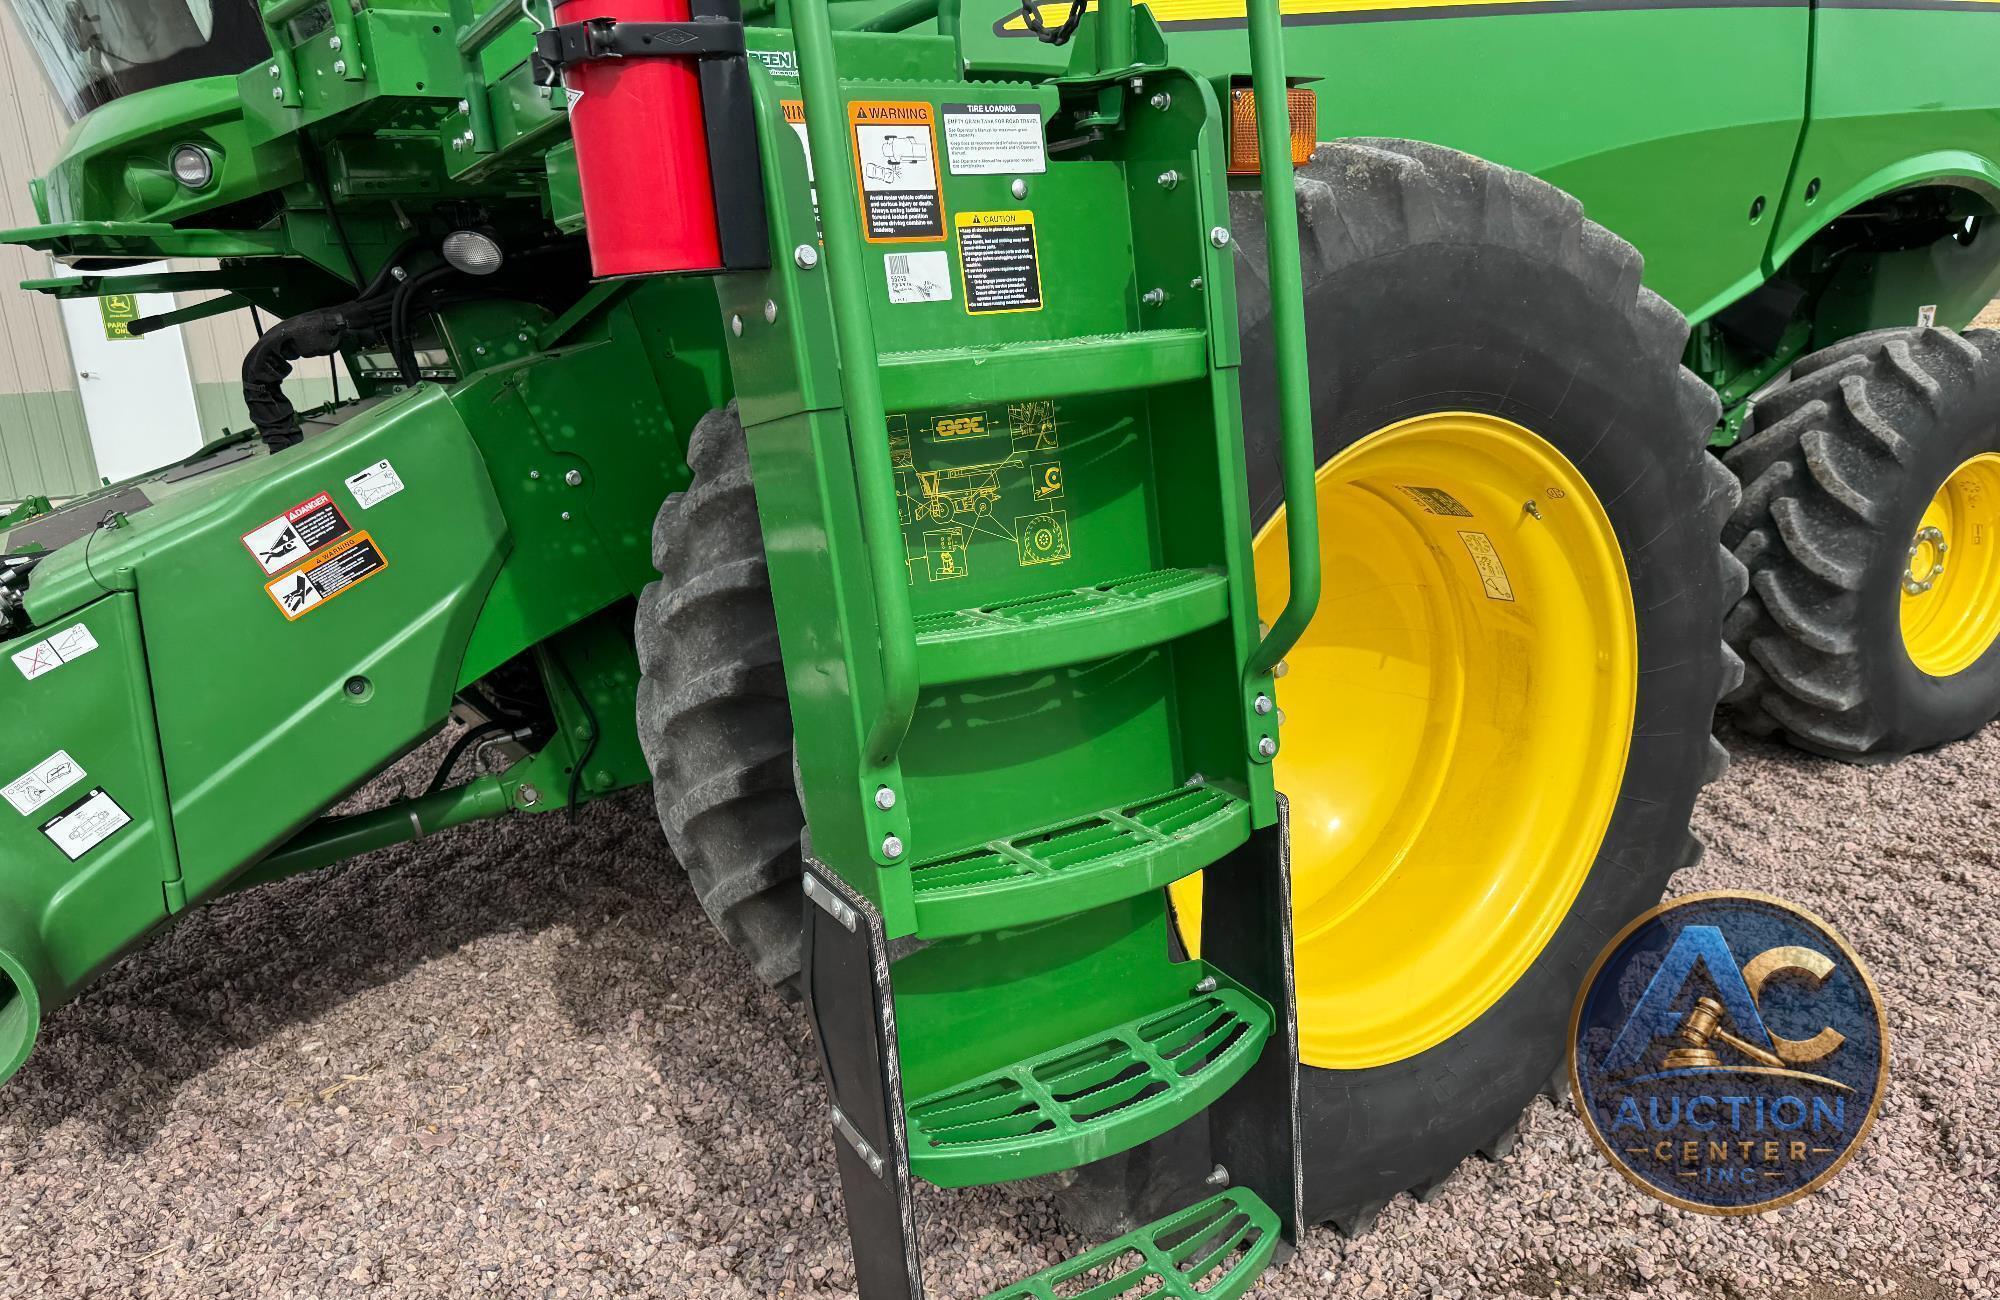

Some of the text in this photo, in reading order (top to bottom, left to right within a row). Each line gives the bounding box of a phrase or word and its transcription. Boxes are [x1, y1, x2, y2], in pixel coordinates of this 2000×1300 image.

[868, 107, 928, 120] WARNING
[984, 215, 1016, 223] CAUTION
[295, 495, 328, 516] DANGER
[322, 540, 355, 560] WARNING
